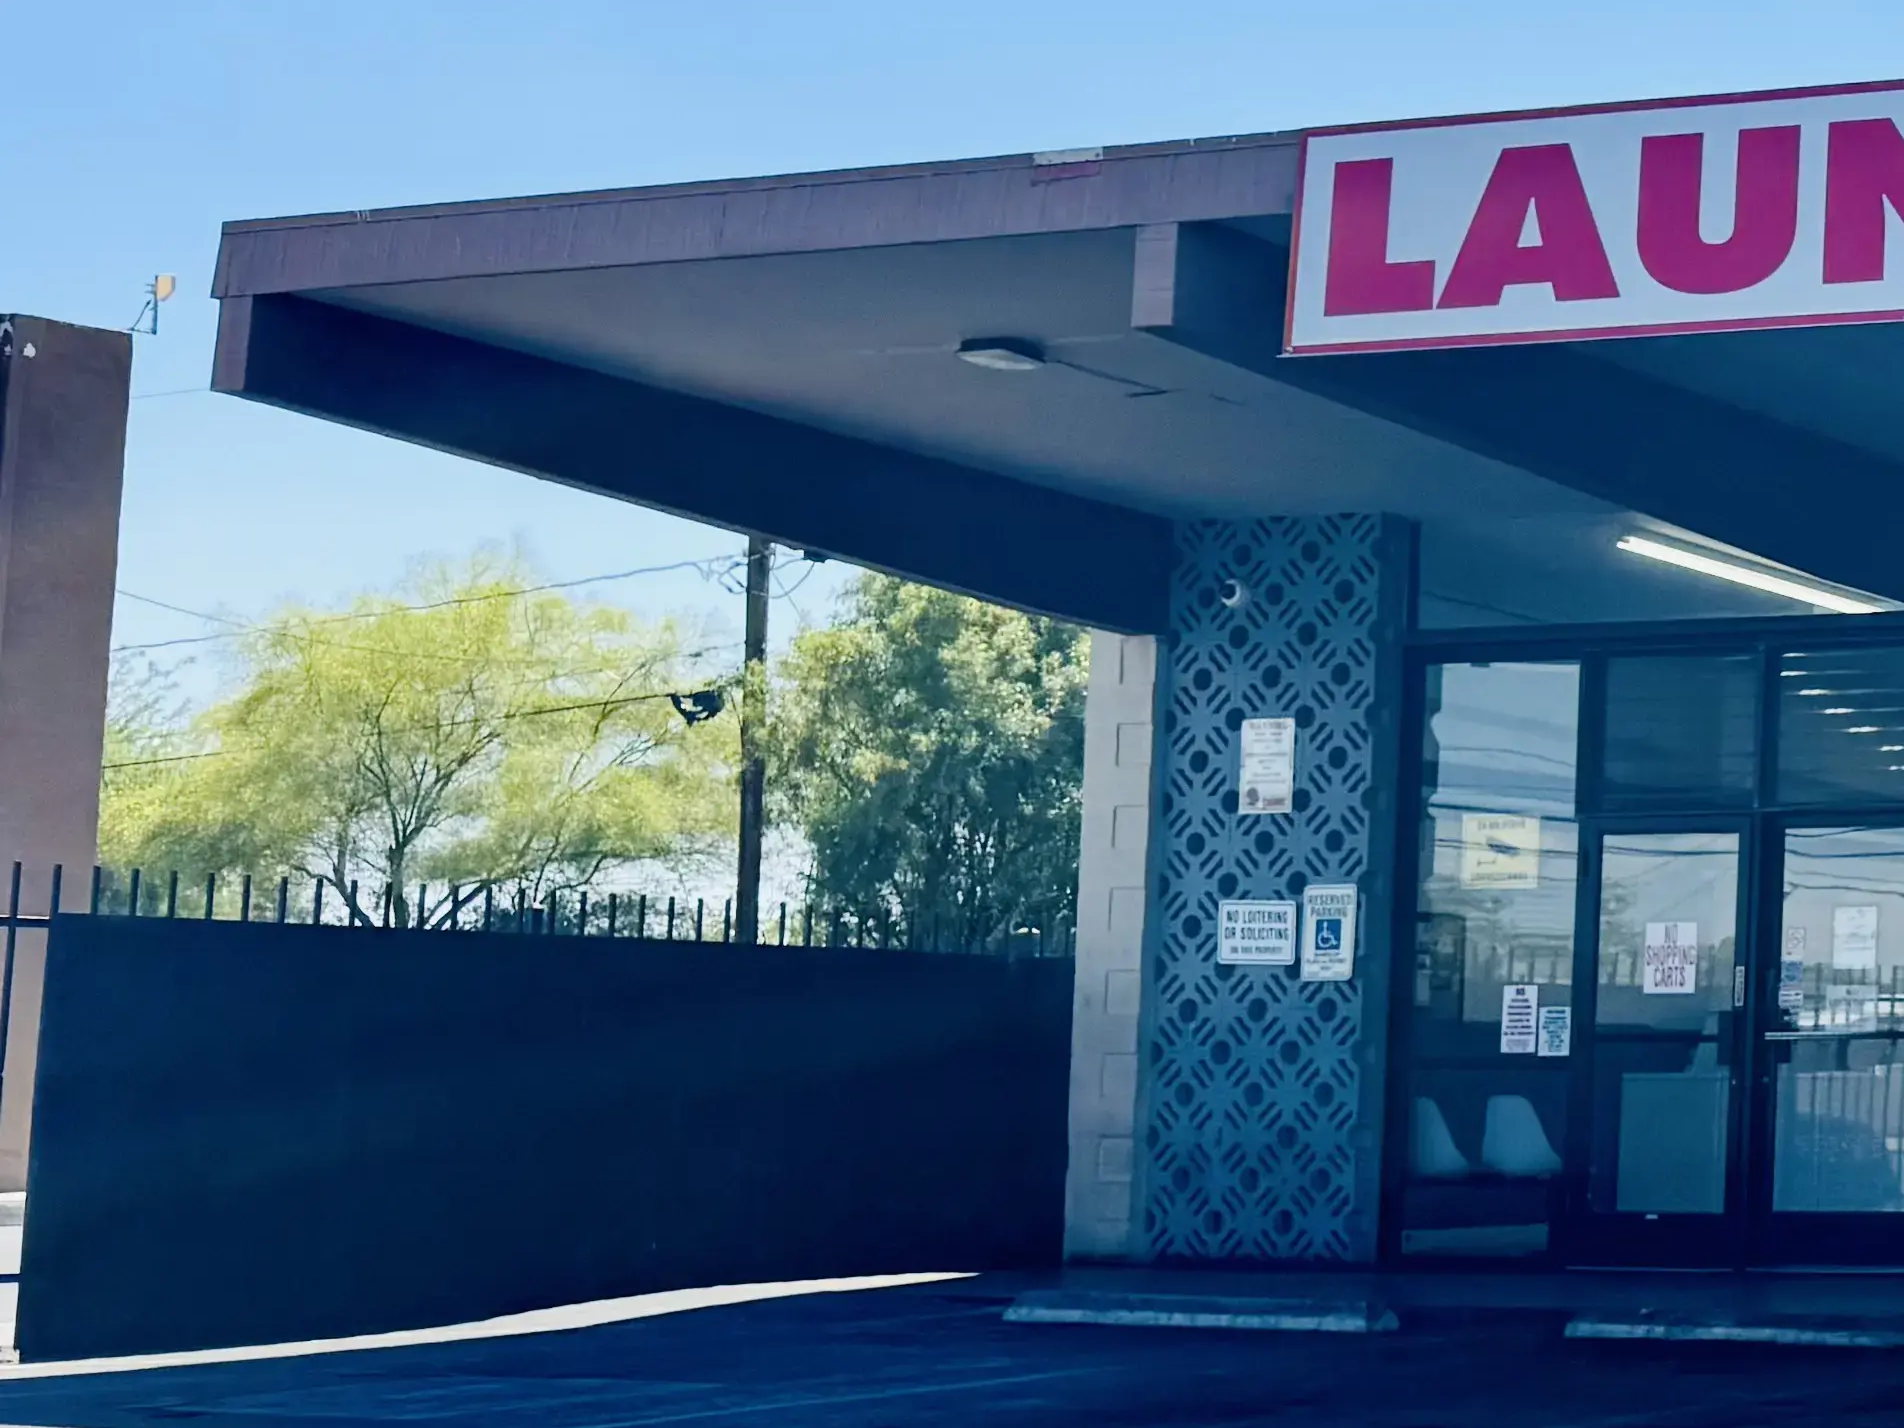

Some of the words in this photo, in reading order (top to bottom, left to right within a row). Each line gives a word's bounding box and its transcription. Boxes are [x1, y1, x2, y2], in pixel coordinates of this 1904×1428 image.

[1308, 894, 1351, 905] RESERVED
[1227, 910, 1239, 923] NO
[1242, 910, 1288, 924] LOITERING
[1310, 906, 1347, 917] PARKING
[1224, 927, 1236, 940] OR
[1241, 927, 1289, 941] SOLICITING
[1664, 923, 1678, 944] NO
[1646, 944, 1697, 966] SHOPPING
[1654, 966, 1686, 987] CARTS
